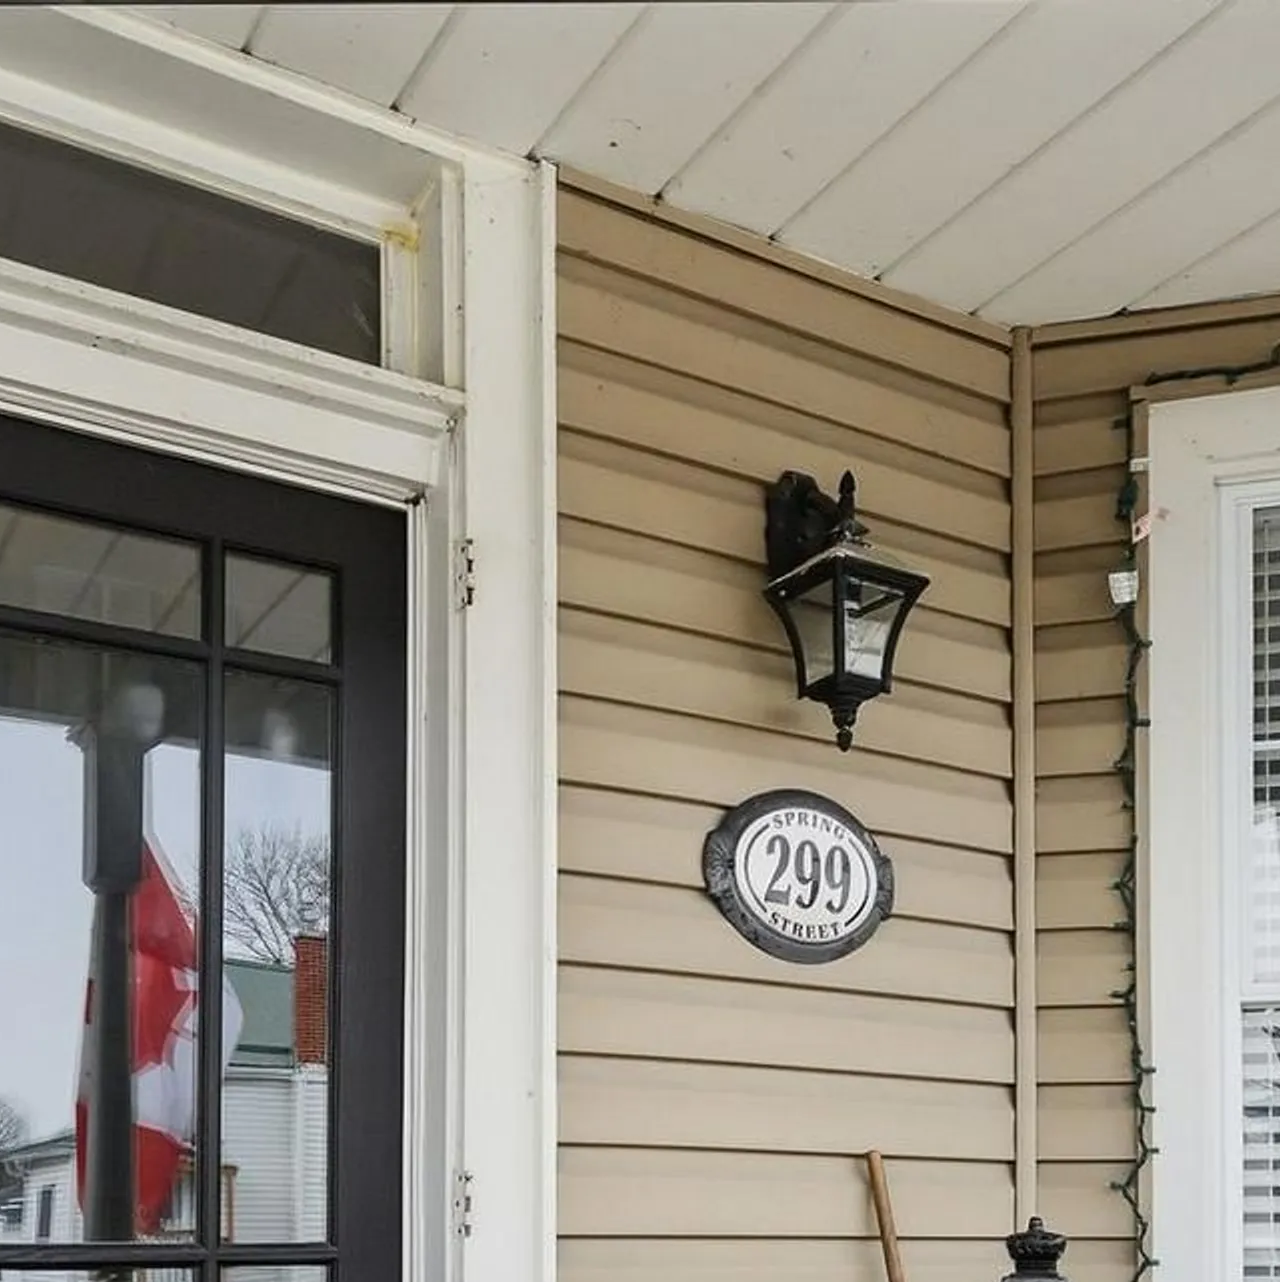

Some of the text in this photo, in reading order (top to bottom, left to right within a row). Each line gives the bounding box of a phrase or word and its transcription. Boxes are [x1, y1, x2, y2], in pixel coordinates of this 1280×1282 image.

[773, 812, 848, 840] SPRING
[764, 835, 851, 914] 299
[769, 912, 842, 938] STREET
